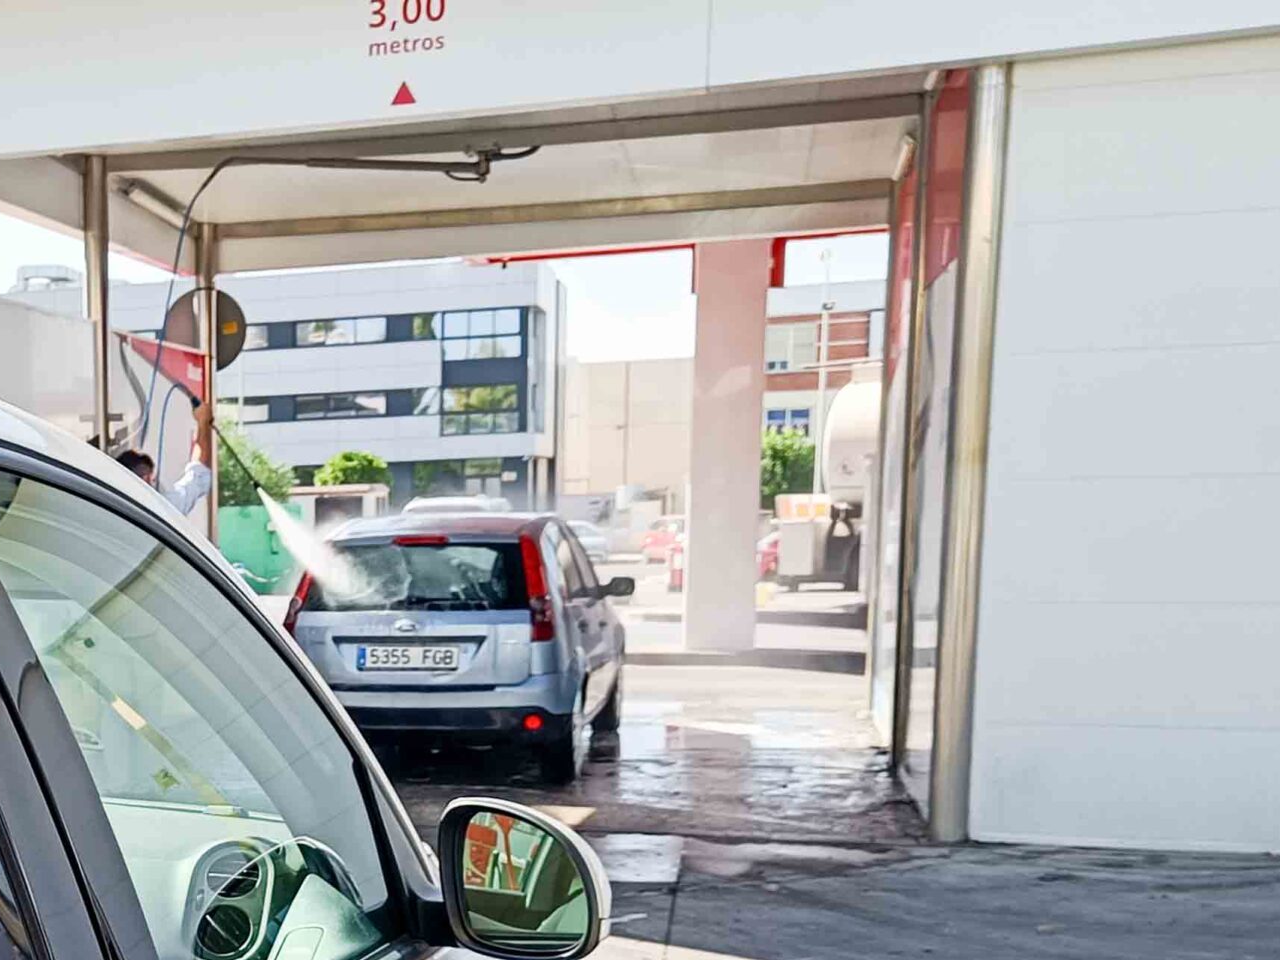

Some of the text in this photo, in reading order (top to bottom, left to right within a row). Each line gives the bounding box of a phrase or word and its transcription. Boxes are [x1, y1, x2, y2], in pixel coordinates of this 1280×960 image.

[369, 0, 446, 31] 3,00
[369, 36, 445, 56] metros
[370, 648, 454, 665] 5355 FGB
